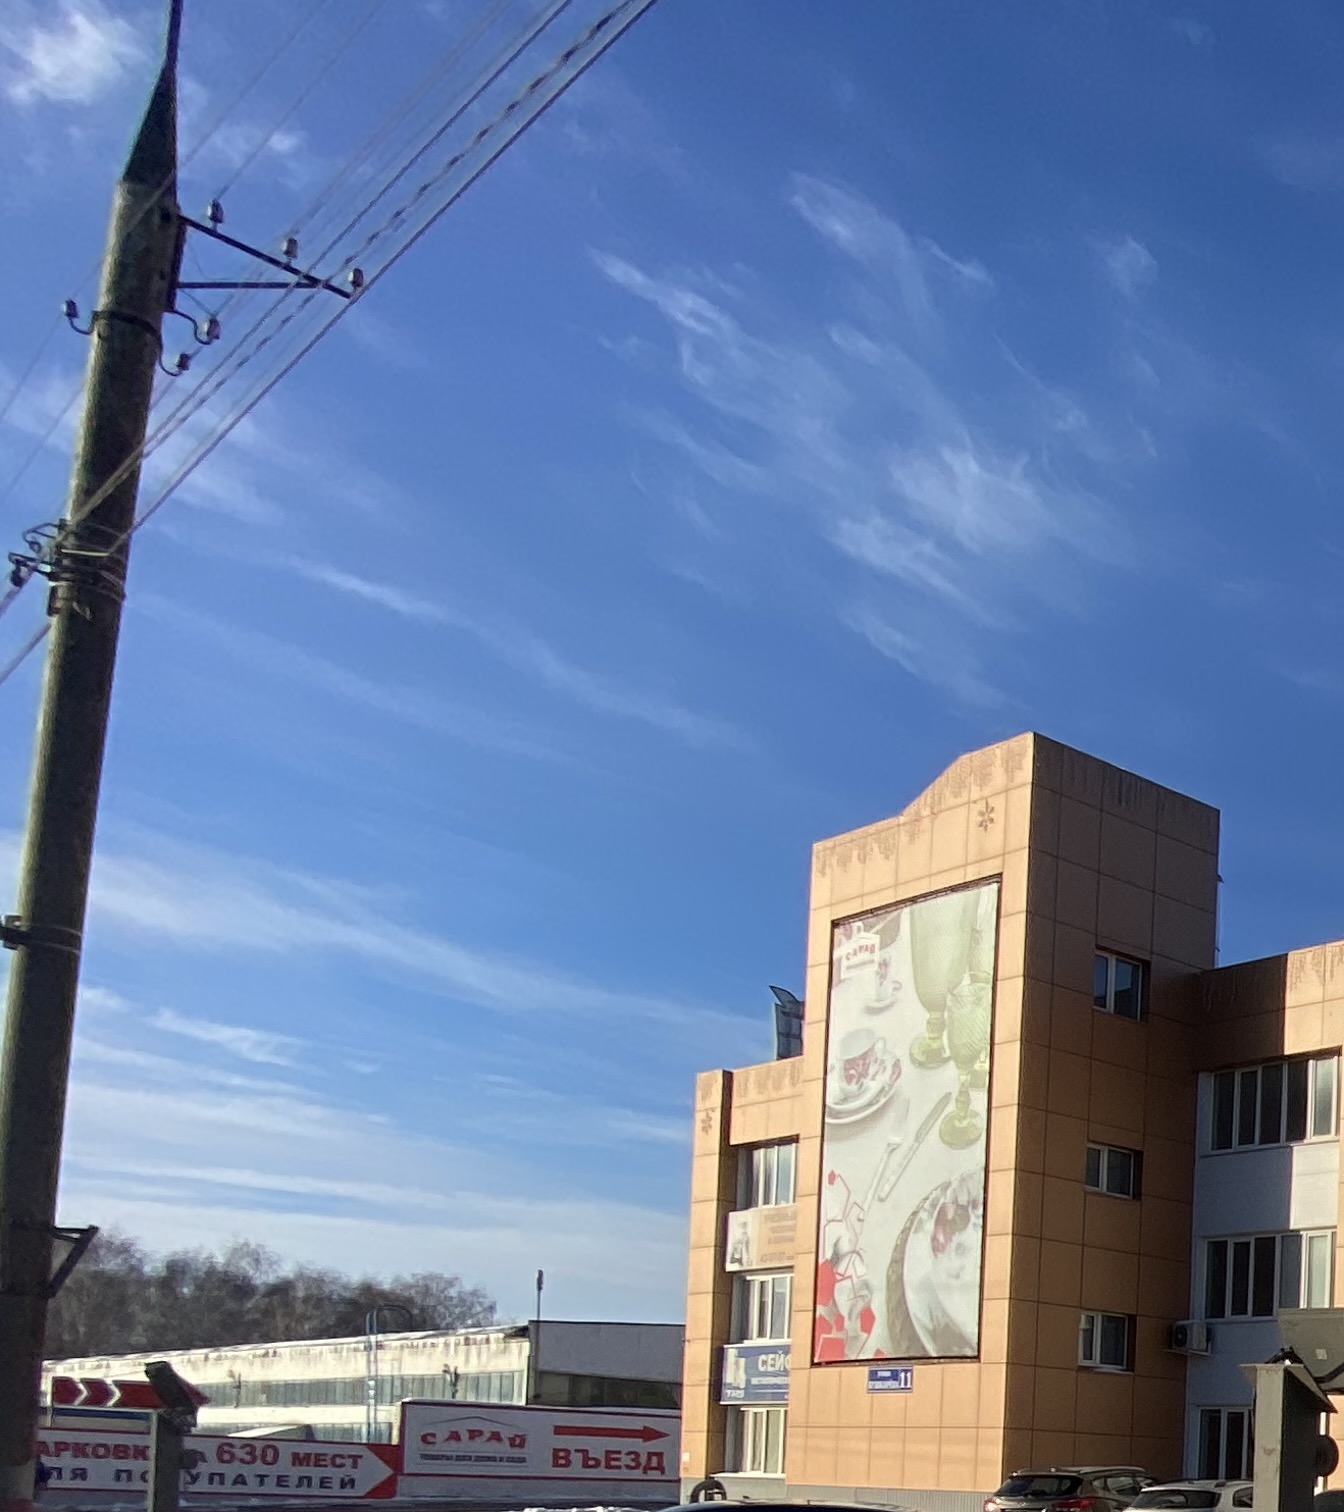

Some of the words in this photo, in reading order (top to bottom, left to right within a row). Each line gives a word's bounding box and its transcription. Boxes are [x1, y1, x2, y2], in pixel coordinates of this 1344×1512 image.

[899, 1371, 912, 1388] 11
[420, 1429, 527, 1449] САРАЙ
[34, 1441, 150, 1461] АРКОВК
[215, 1442, 280, 1466] 630
[291, 1451, 364, 1469] МЕСТ
[552, 1448, 666, 1475] ВЪЕЗД
[46, 1466, 88, 1482] ЛЯ
[113, 1469, 356, 1490] ПОУПАТЕЛЕЙ
